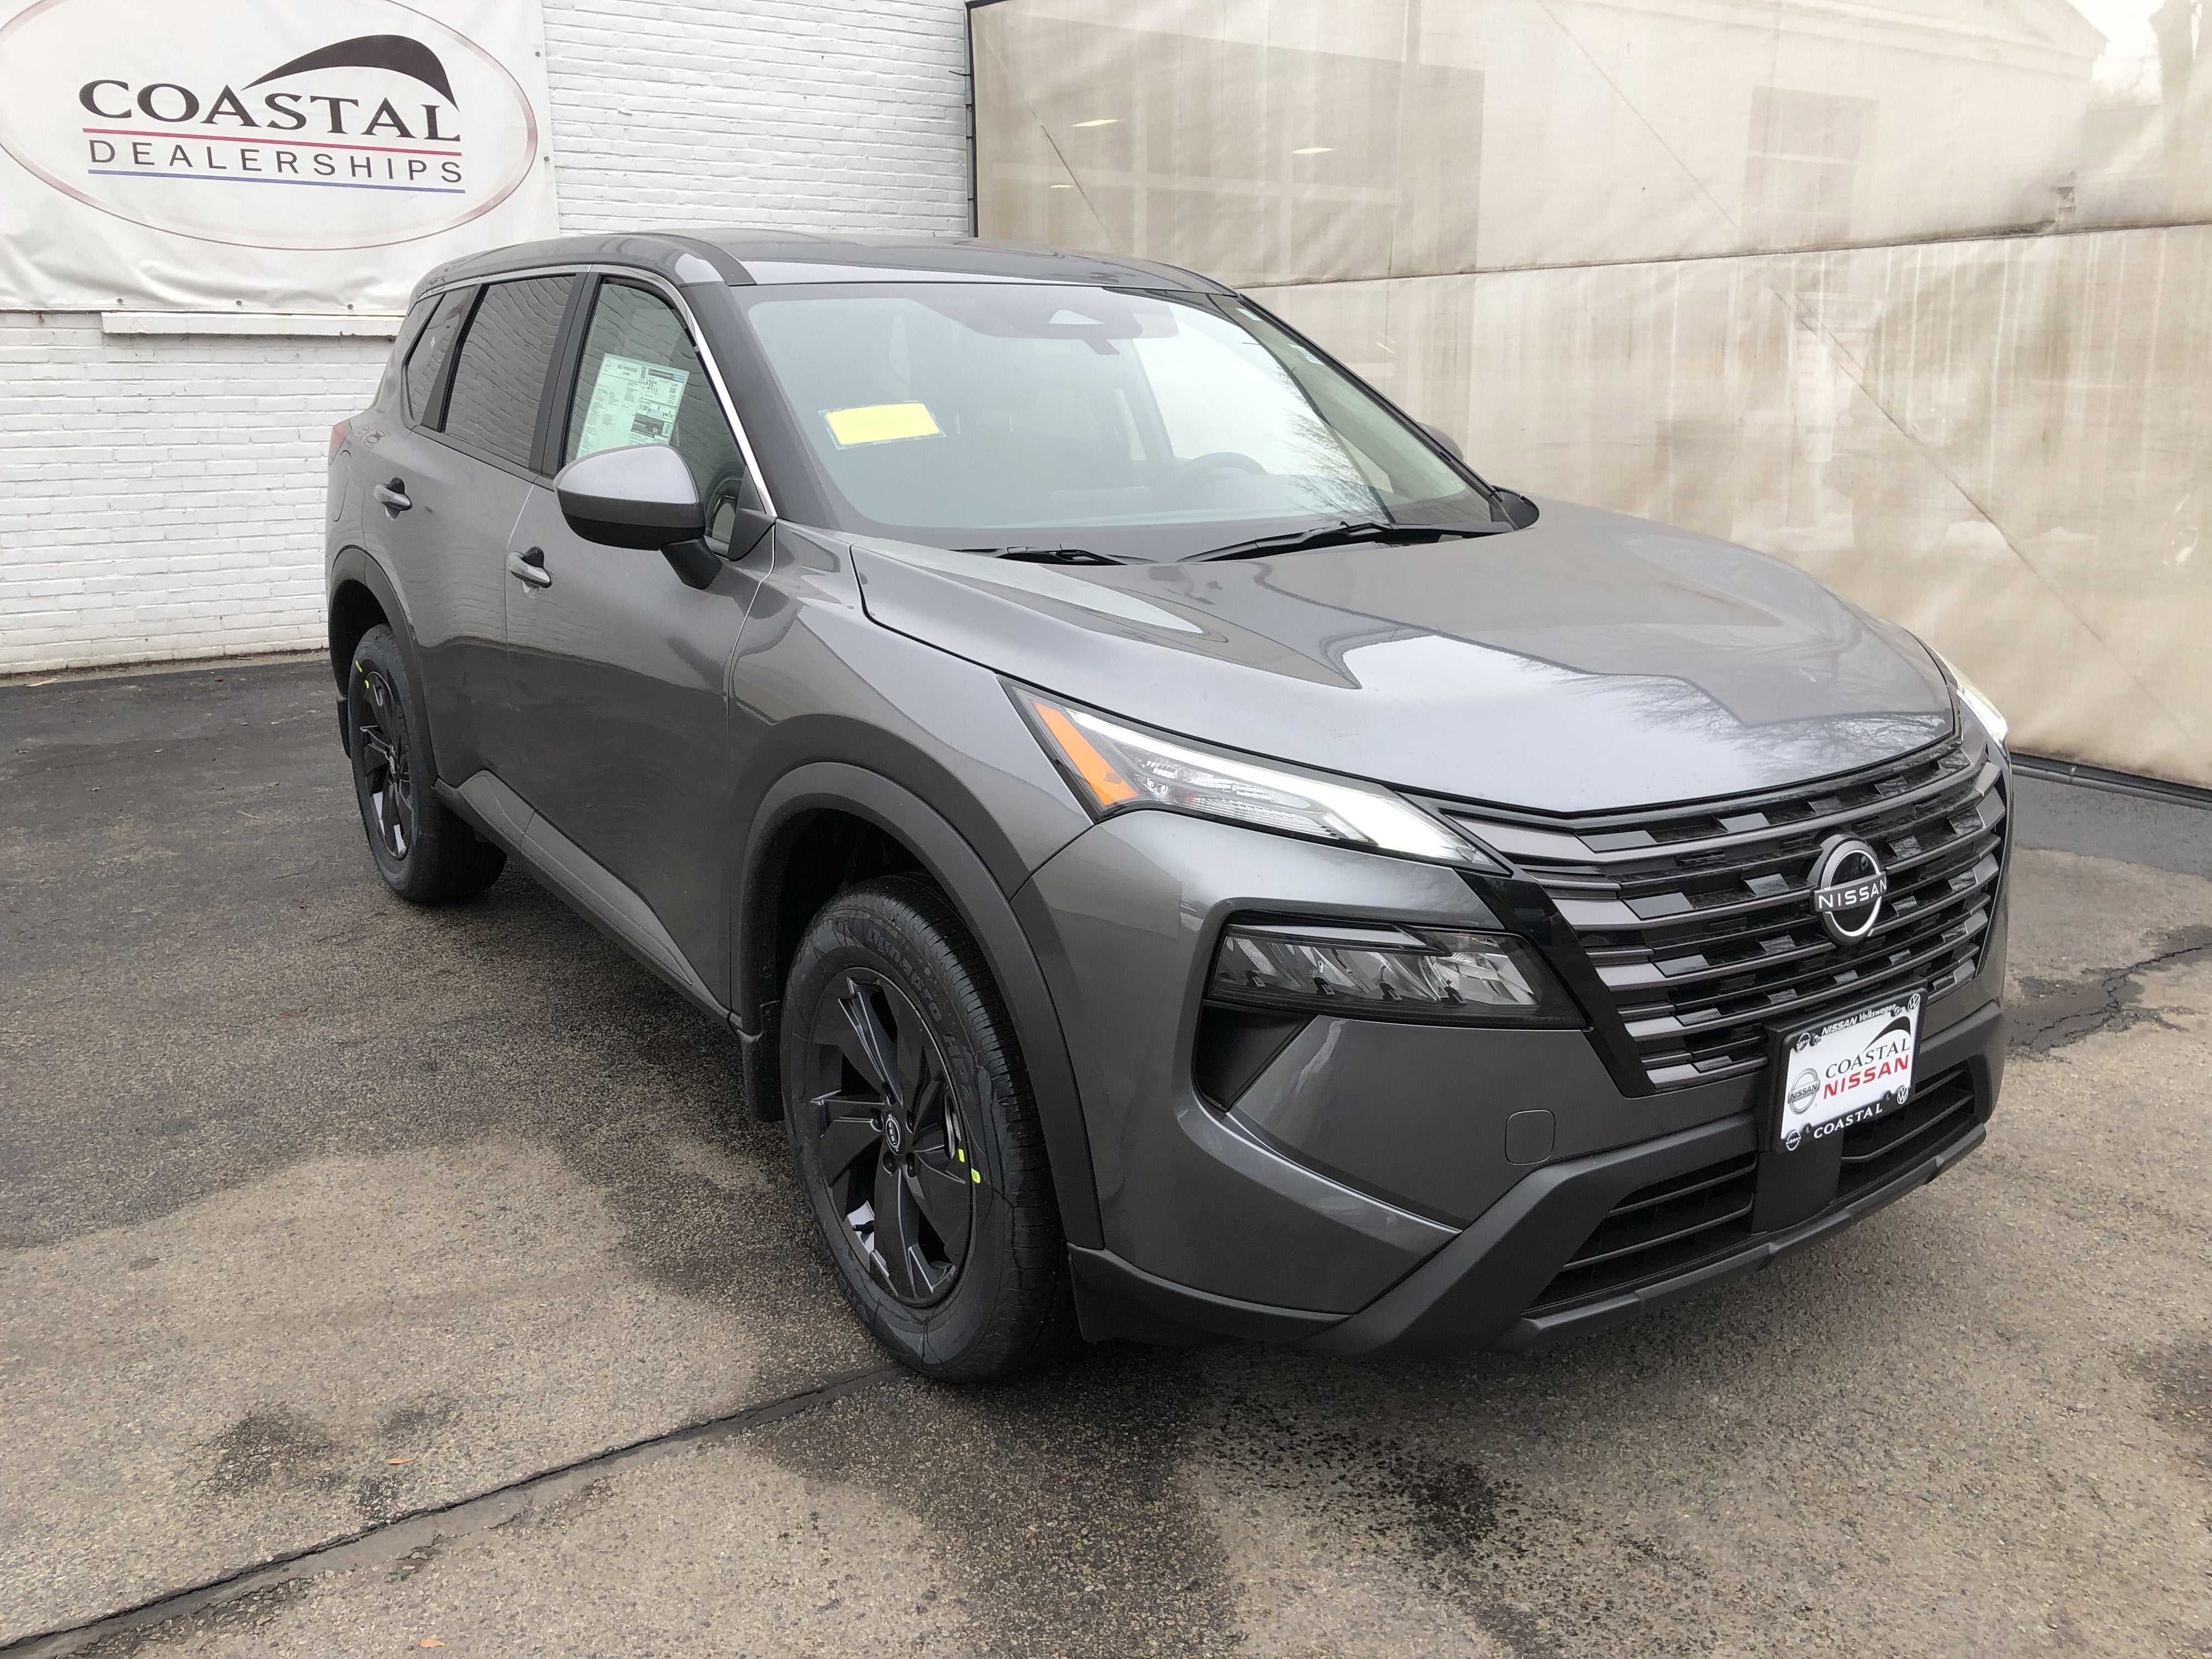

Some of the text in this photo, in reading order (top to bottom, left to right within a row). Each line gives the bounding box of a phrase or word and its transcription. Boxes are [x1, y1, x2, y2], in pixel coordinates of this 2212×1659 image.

[78, 78, 461, 142] COASTAL
[90, 139, 463, 184] DEALERSHIPS
[1818, 876, 1887, 909] NISSAN
[1821, 1003, 1897, 1036] NISSAN Volkswagen
[1823, 1054, 1909, 1100] NISSAN
[1825, 1038, 1911, 1079] COASTAL
[1790, 1083, 1818, 1100] NISSAN
[1813, 1103, 1883, 1139] COASTAL
